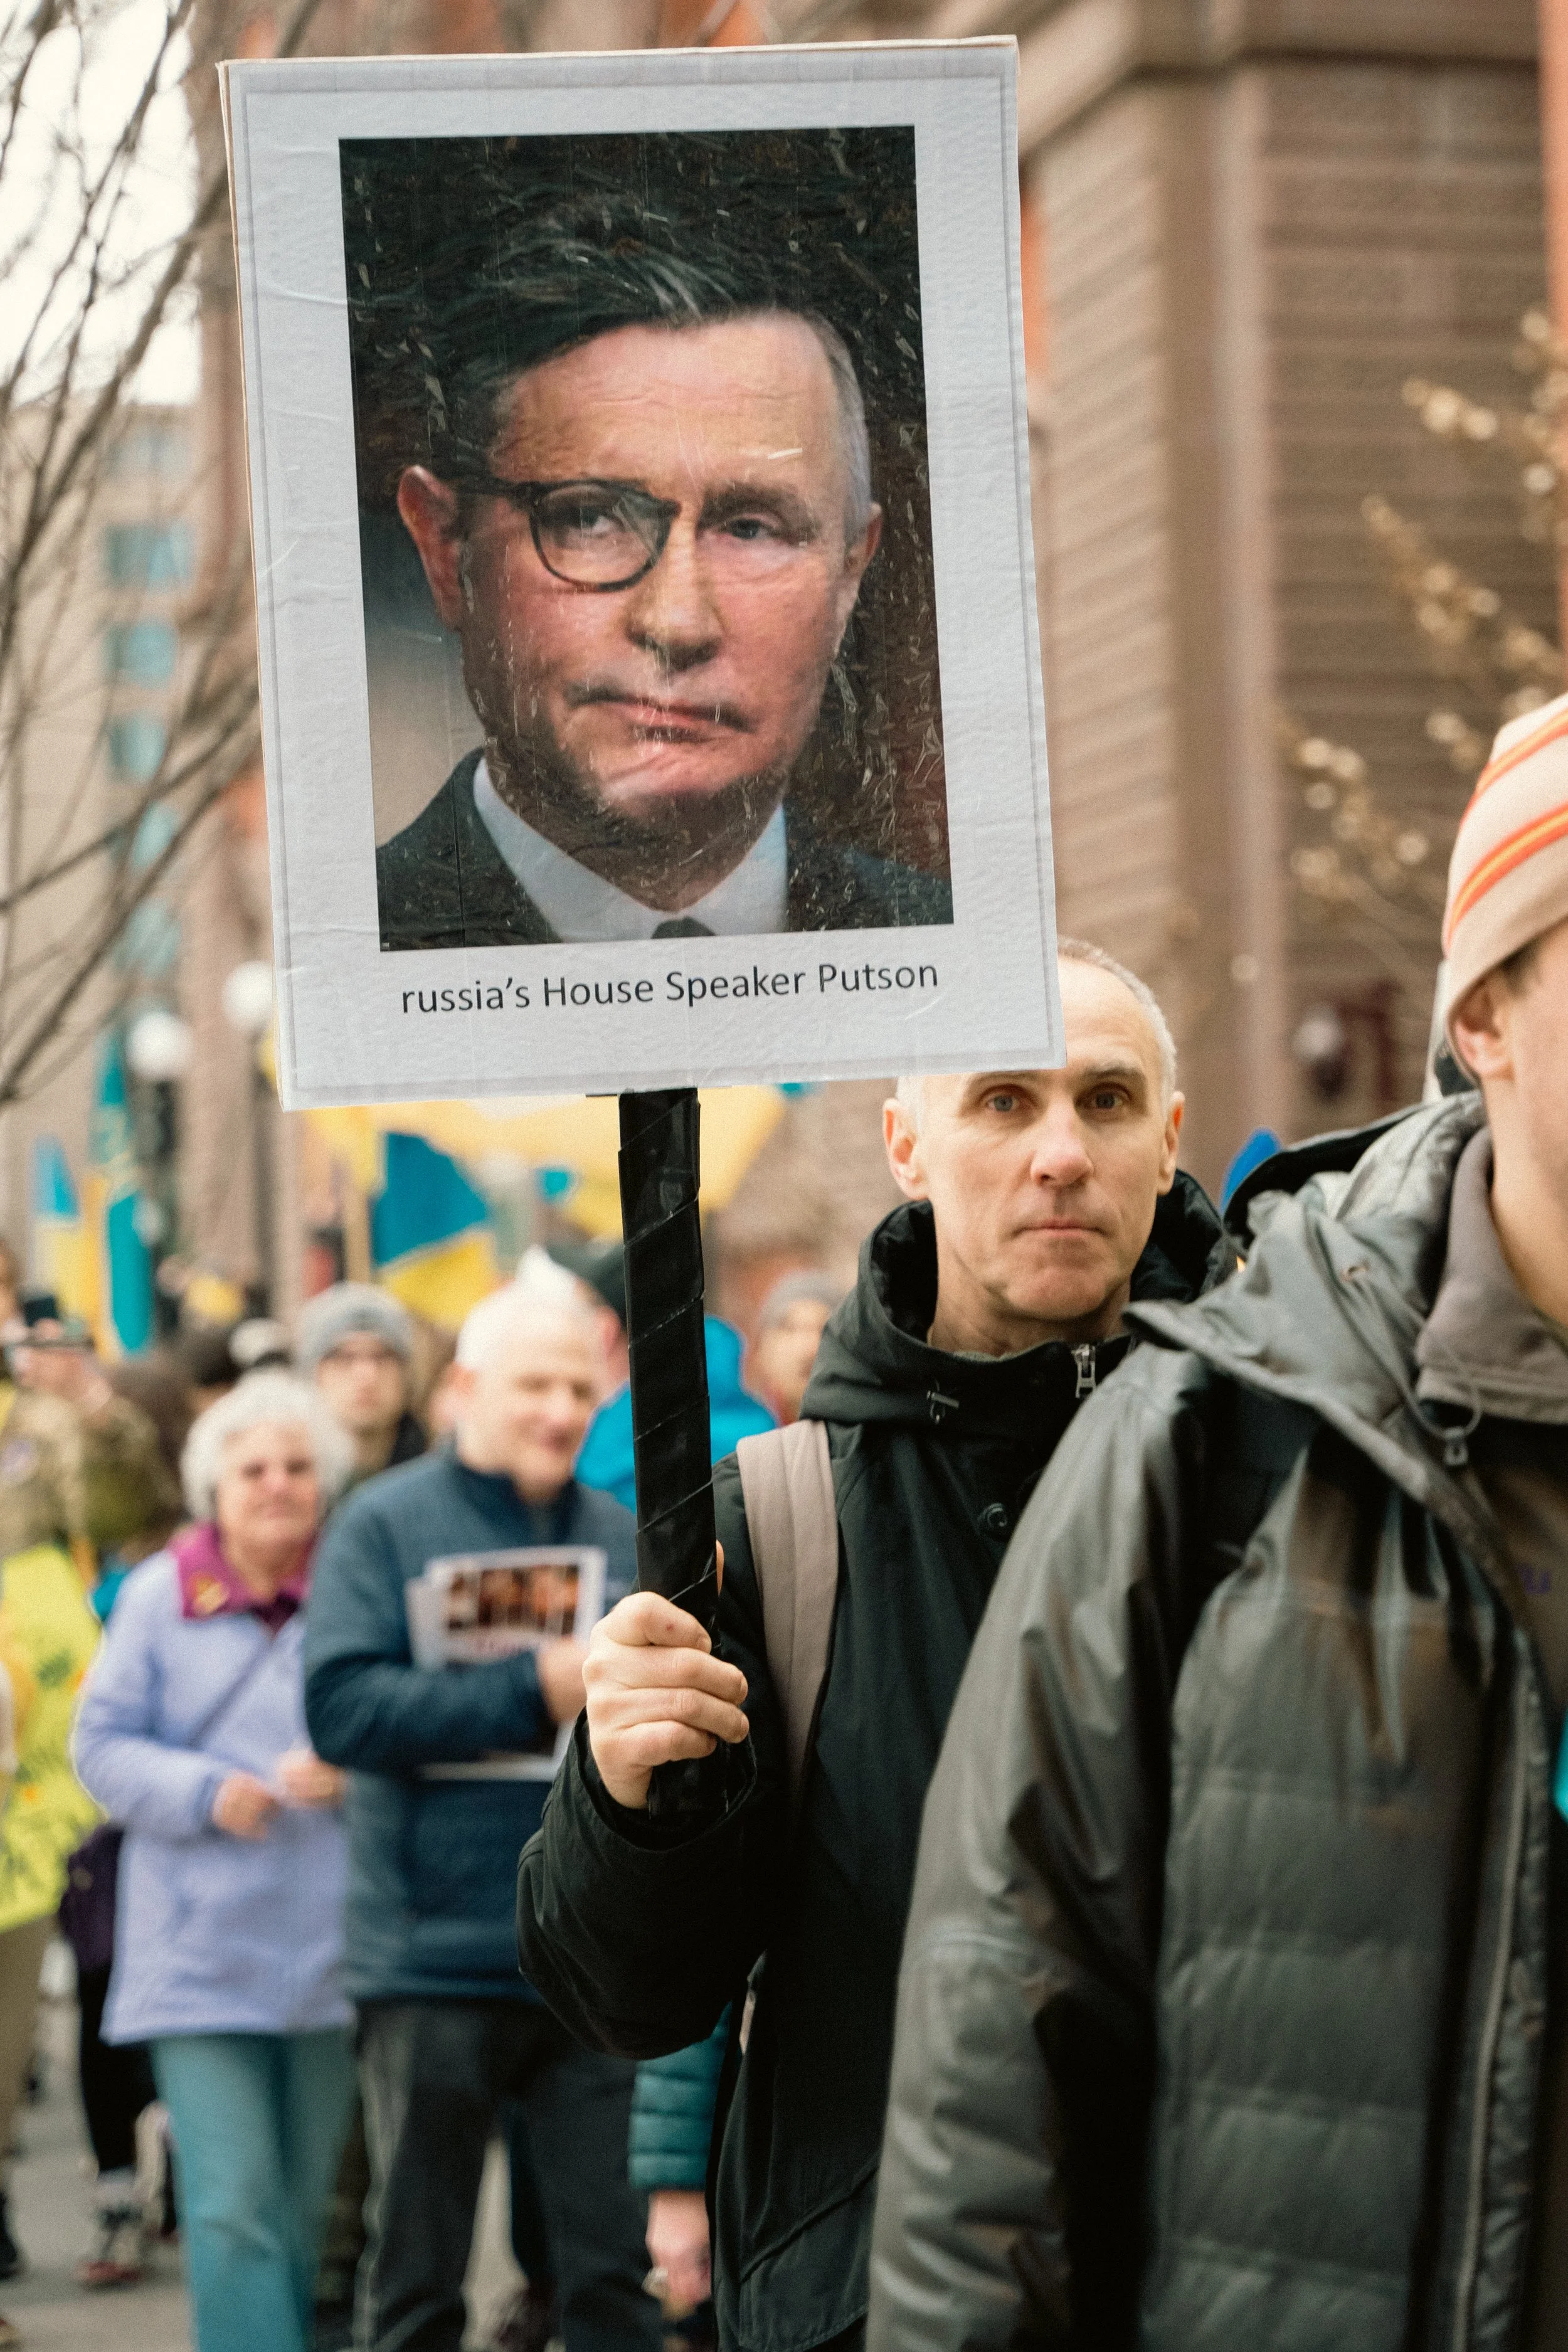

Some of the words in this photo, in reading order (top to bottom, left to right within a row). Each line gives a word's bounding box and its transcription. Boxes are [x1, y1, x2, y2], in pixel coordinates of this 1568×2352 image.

[401, 977, 531, 1015] russia’s
[543, 974, 654, 1008] House
[665, 965, 807, 1008] Speaker
[818, 963, 938, 994] Putson
